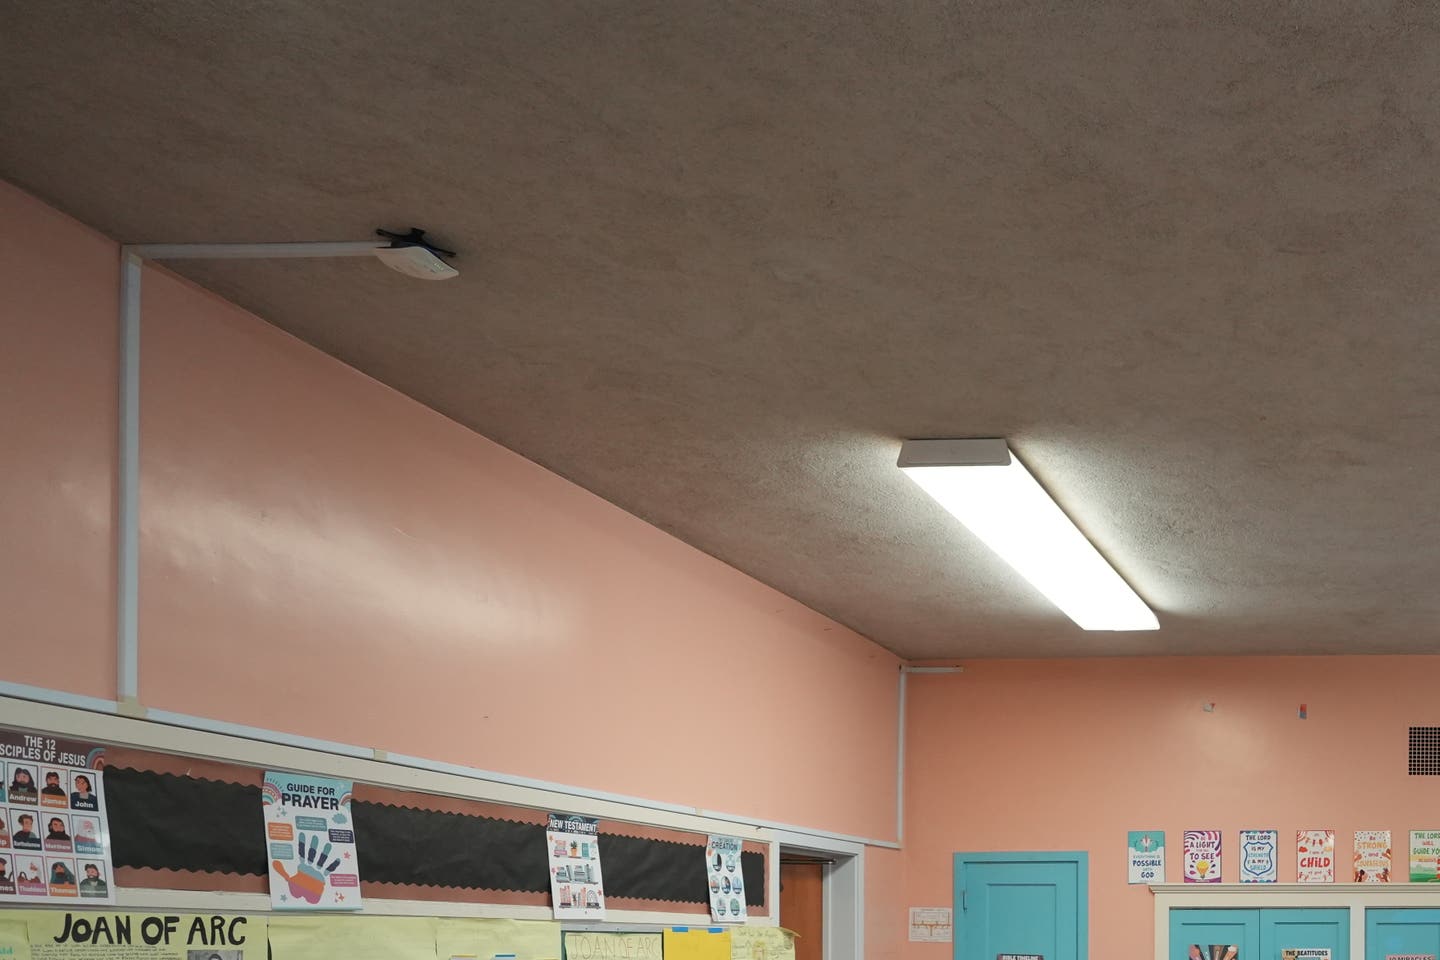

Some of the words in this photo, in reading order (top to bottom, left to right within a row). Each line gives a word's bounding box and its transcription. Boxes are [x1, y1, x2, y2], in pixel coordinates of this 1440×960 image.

[24, 736, 43, 749] THE
[46, 739, 56, 750] 12
[43, 750, 56, 762] OF
[58, 752, 86, 766] JESUS
[286, 783, 315, 794] GUIDE
[317, 786, 335, 796] FOR
[9, 794, 37, 803] Andrew
[75, 801, 94, 809] John
[281, 793, 340, 811] PRAYER
[549, 819, 564, 829] NEW
[565, 820, 597, 833] TESTAMENT
[1196, 841, 1216, 849] LIGHT
[53, 913, 131, 945] JOAN
[141, 916, 180, 945] OF
[186, 915, 247, 946] ARC
[567, 935, 616, 960] JOAN
